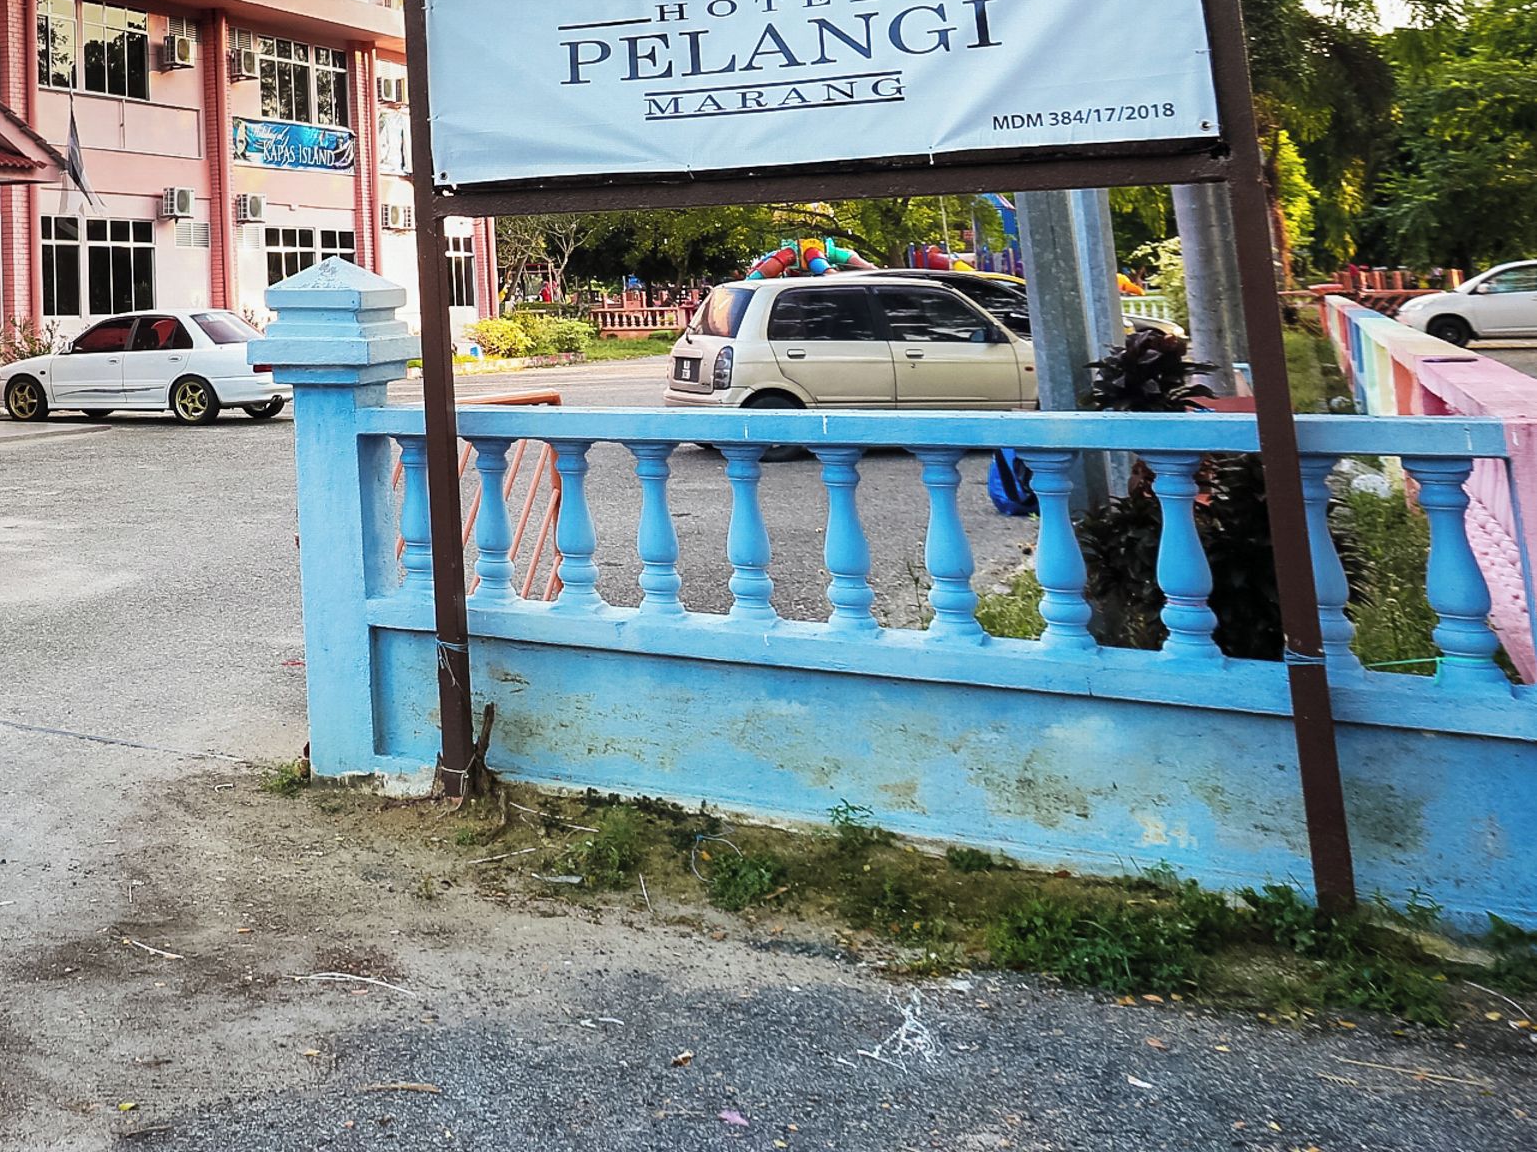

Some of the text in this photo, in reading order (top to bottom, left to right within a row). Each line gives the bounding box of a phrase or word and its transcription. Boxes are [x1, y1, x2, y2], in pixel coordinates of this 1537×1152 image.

[644, 76, 906, 116] MARANG
[993, 102, 1175, 130] MDM 384/17/2018
